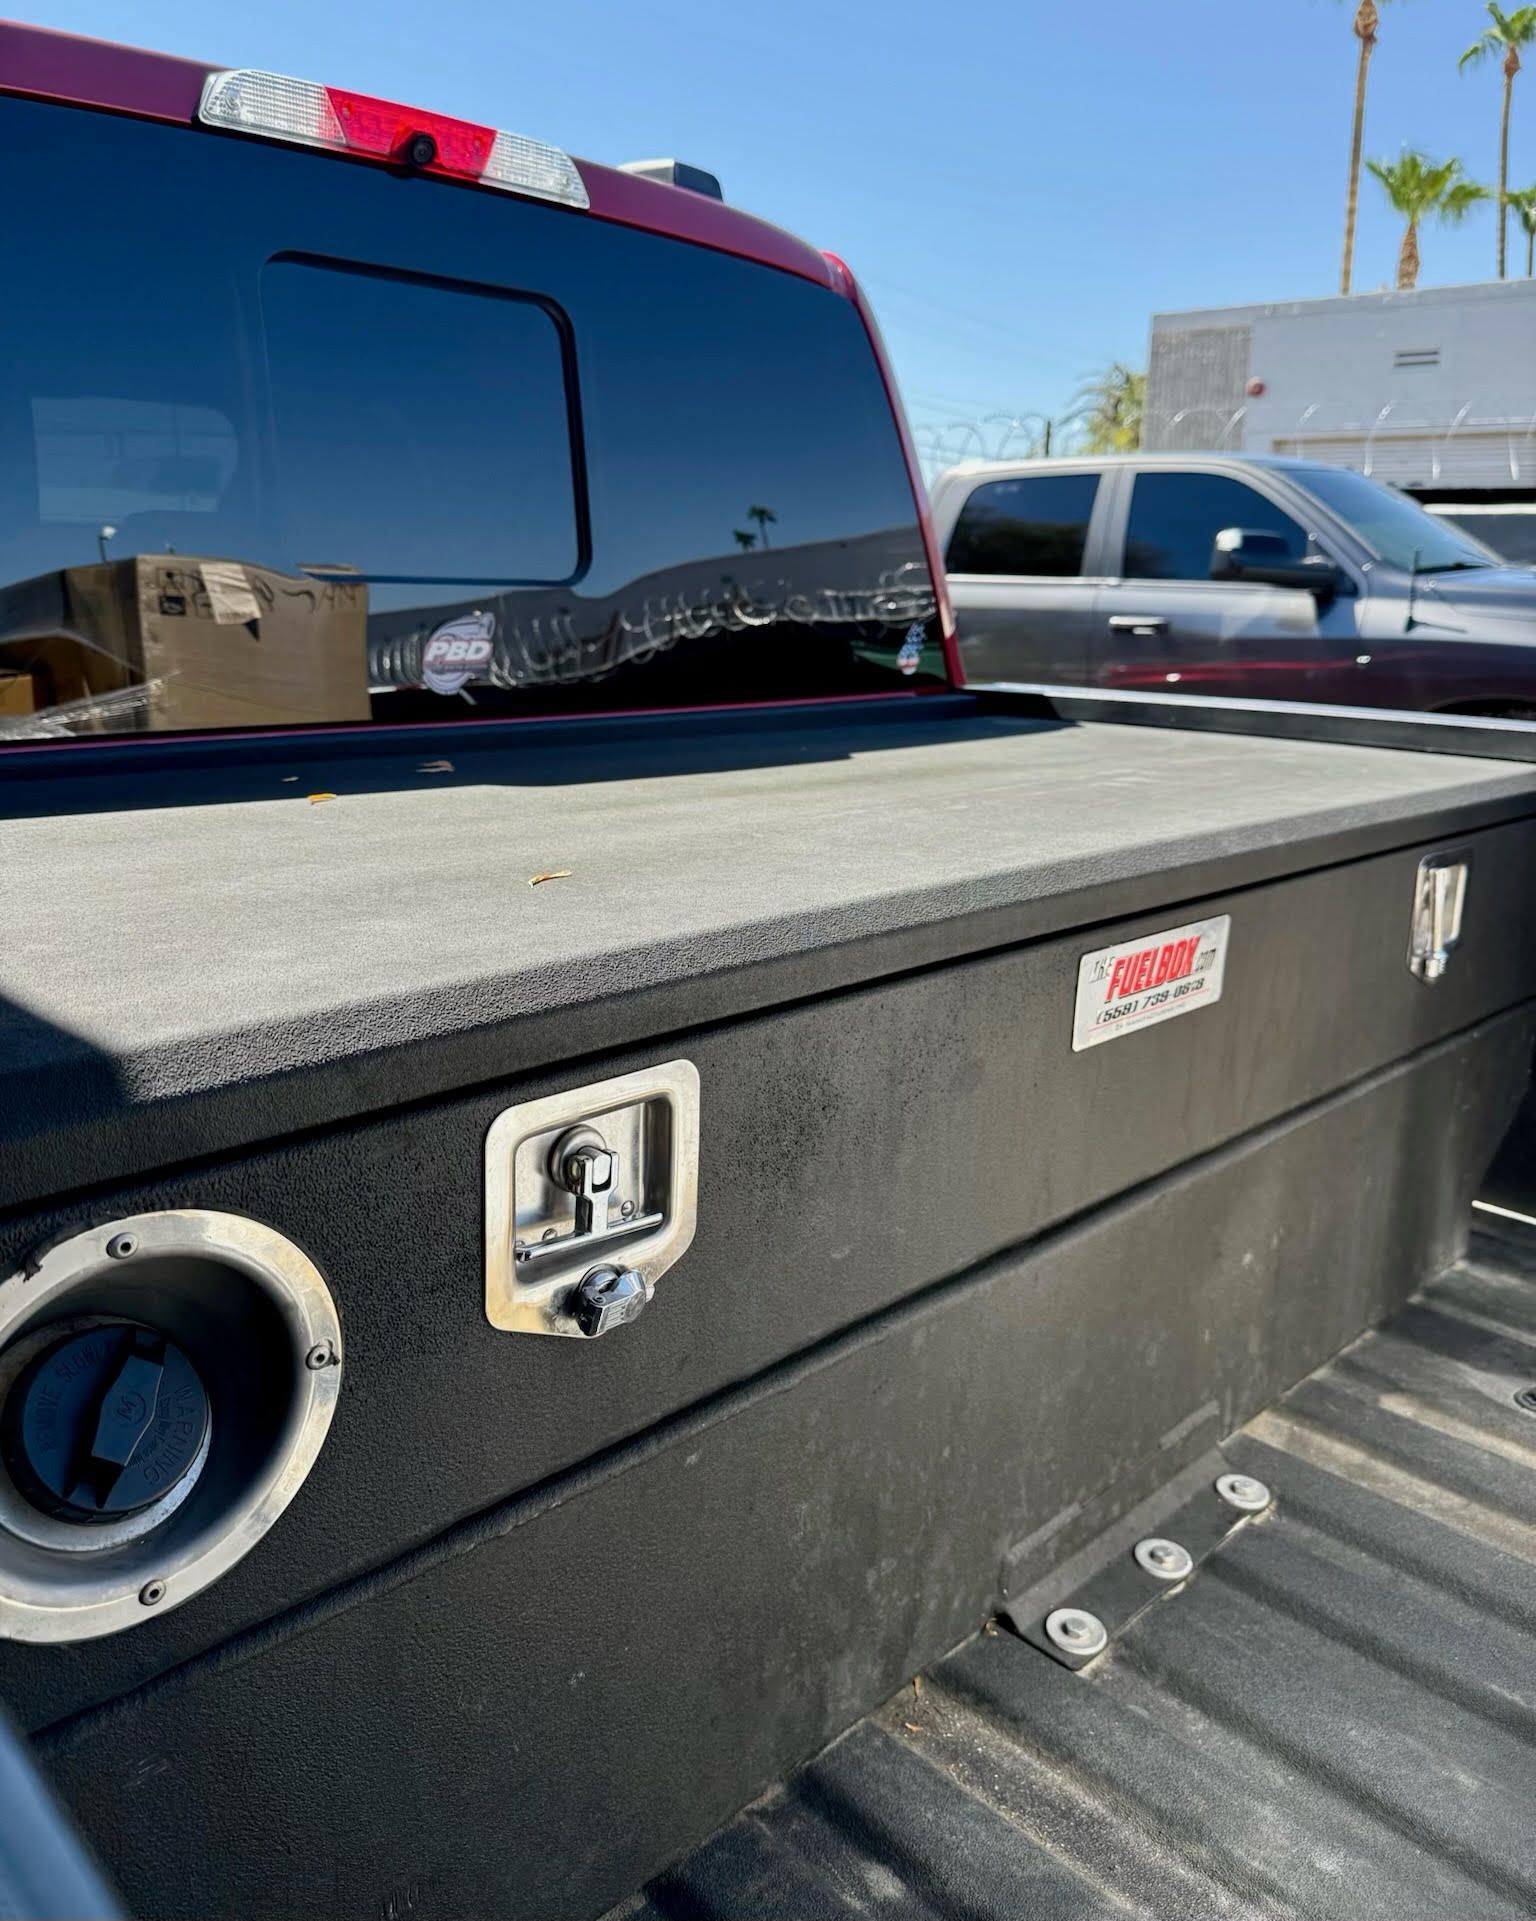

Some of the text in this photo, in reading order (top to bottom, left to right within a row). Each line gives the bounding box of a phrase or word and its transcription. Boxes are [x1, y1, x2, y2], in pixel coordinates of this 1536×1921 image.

[426, 640, 493, 661] PBD
[1104, 934, 1201, 1004] FUELBOX
[144, 1385, 194, 1485] WARNING
